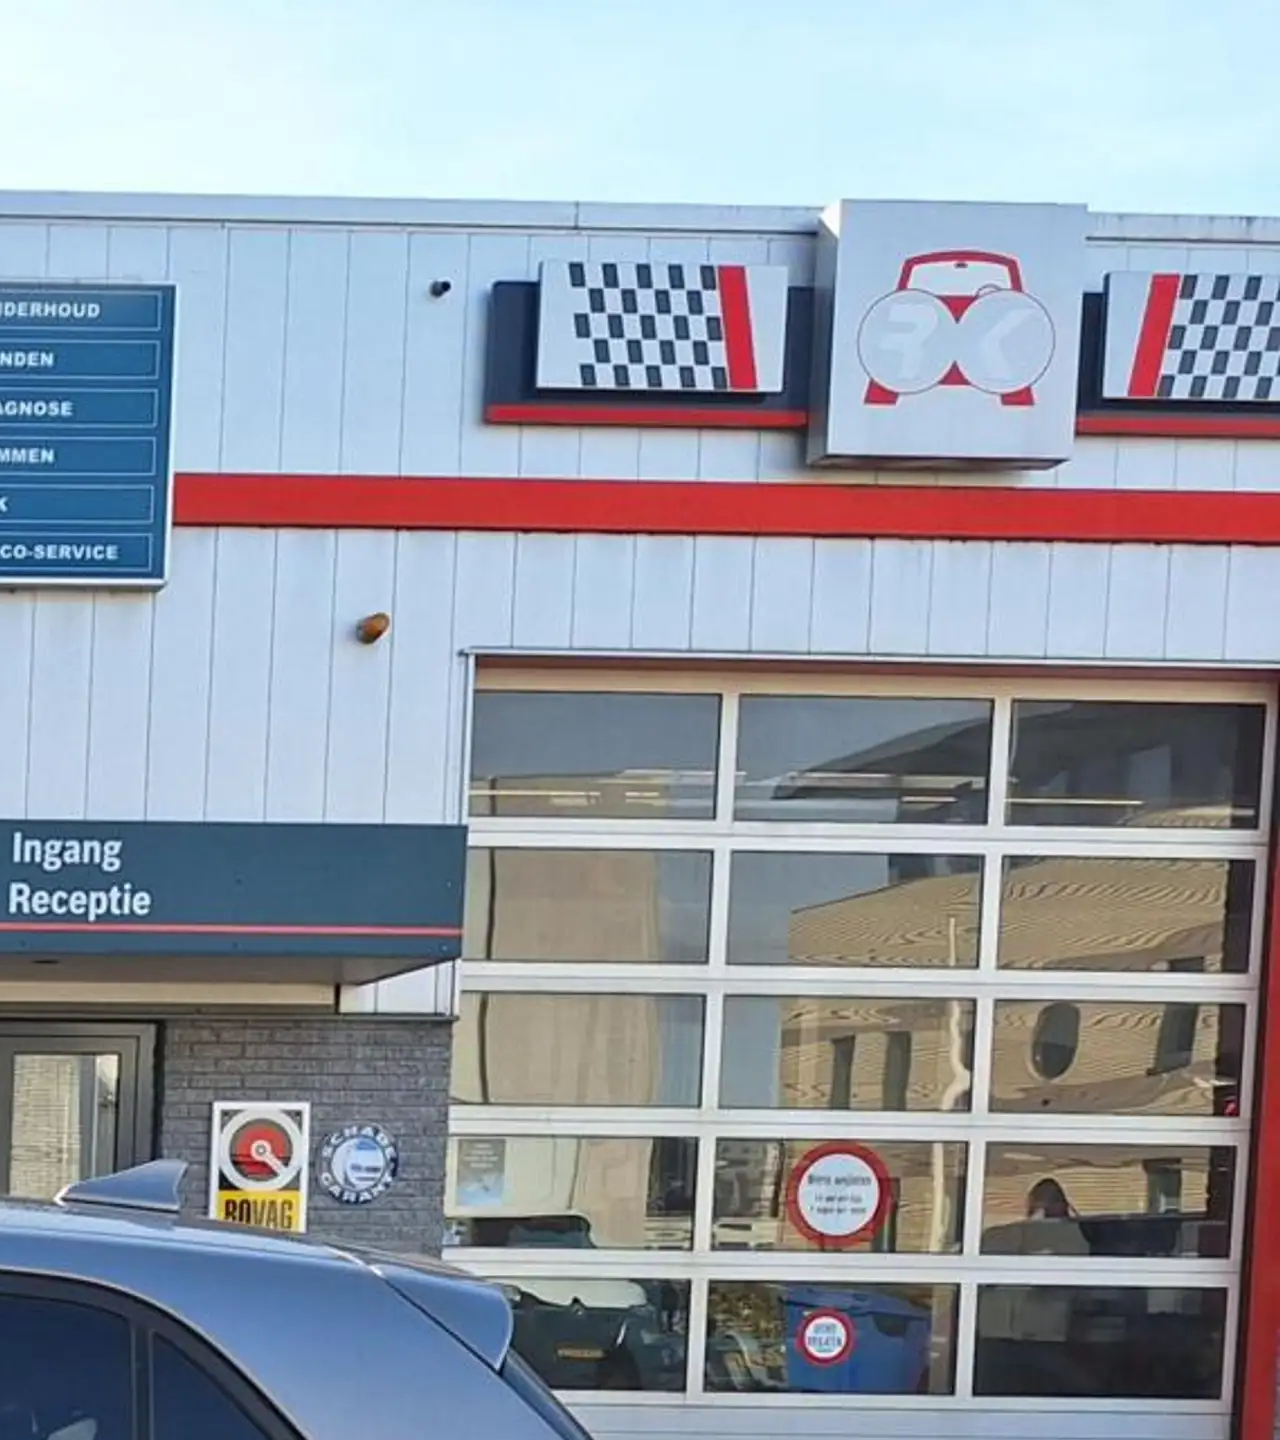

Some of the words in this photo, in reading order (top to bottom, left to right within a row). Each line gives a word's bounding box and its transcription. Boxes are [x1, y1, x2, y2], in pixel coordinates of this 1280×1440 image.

[12, 831, 123, 872] Ingang
[8, 881, 152, 922] Receptie
[224, 1198, 294, 1229] BOVAG
